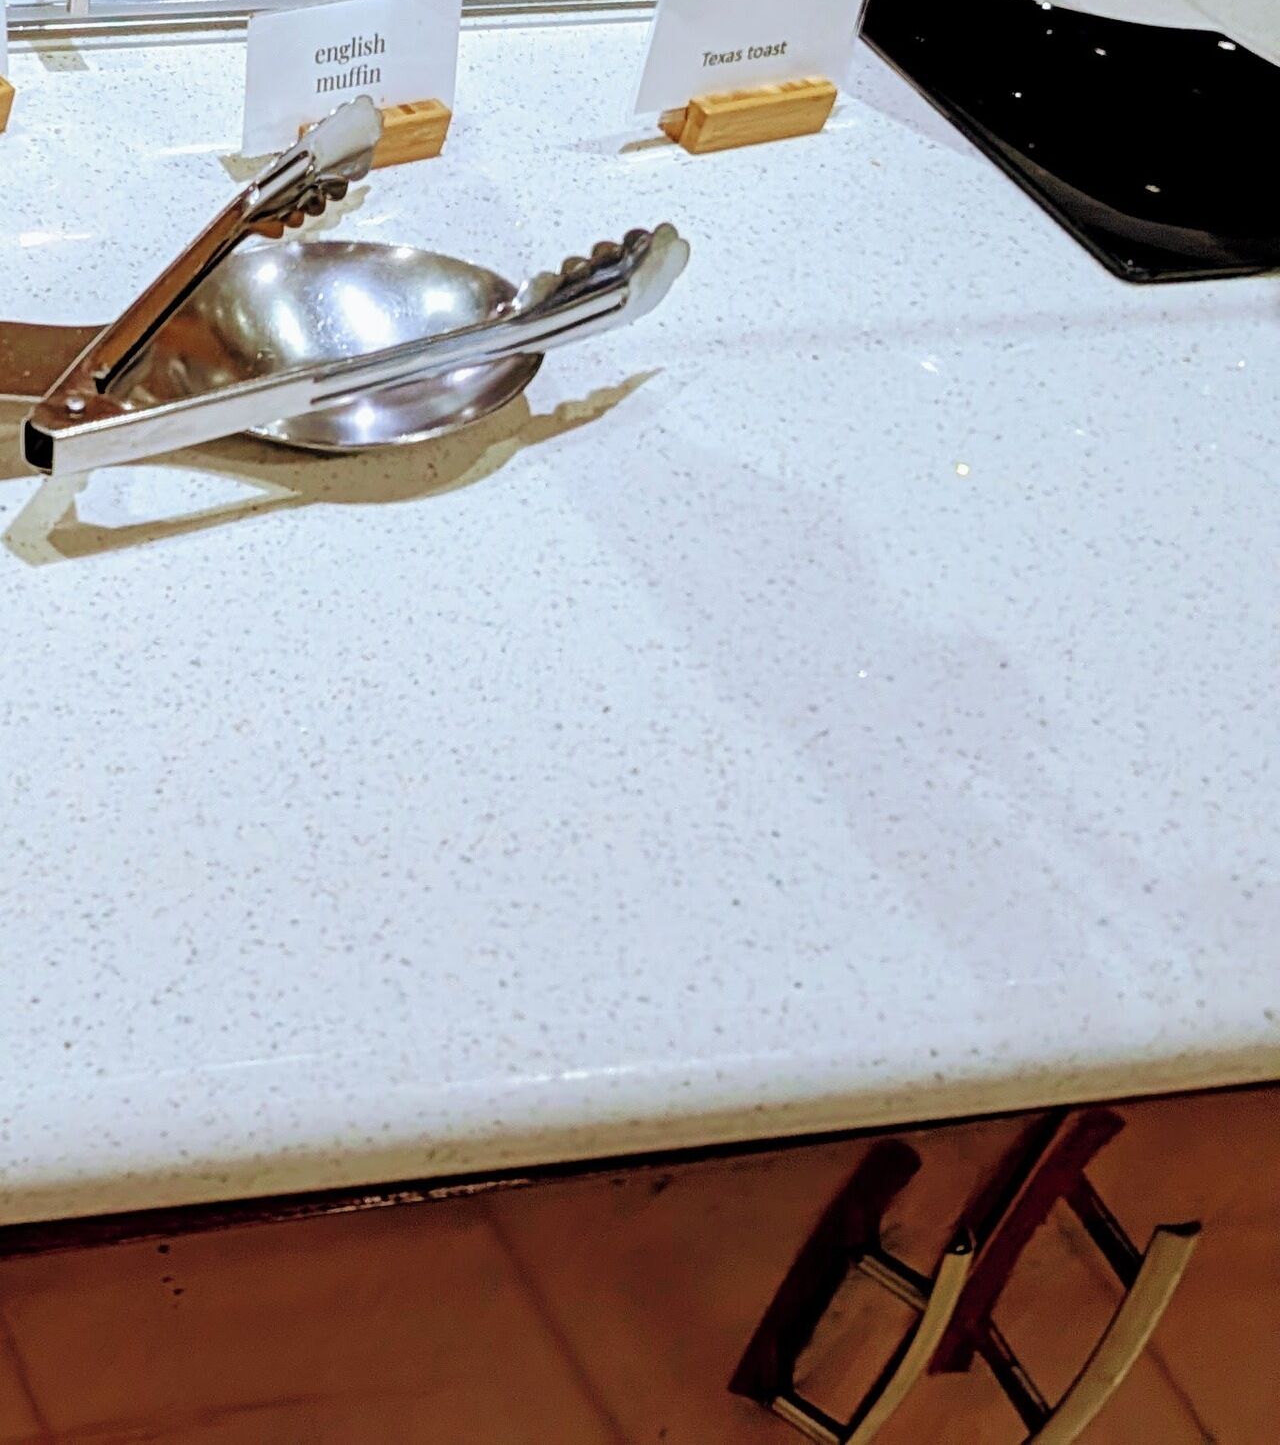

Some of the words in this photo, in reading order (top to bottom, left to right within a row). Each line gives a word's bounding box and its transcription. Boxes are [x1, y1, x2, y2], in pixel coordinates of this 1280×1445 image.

[314, 31, 386, 65] english
[701, 50, 743, 67] Texas
[747, 40, 788, 61] toast
[316, 63, 382, 94] muffin
